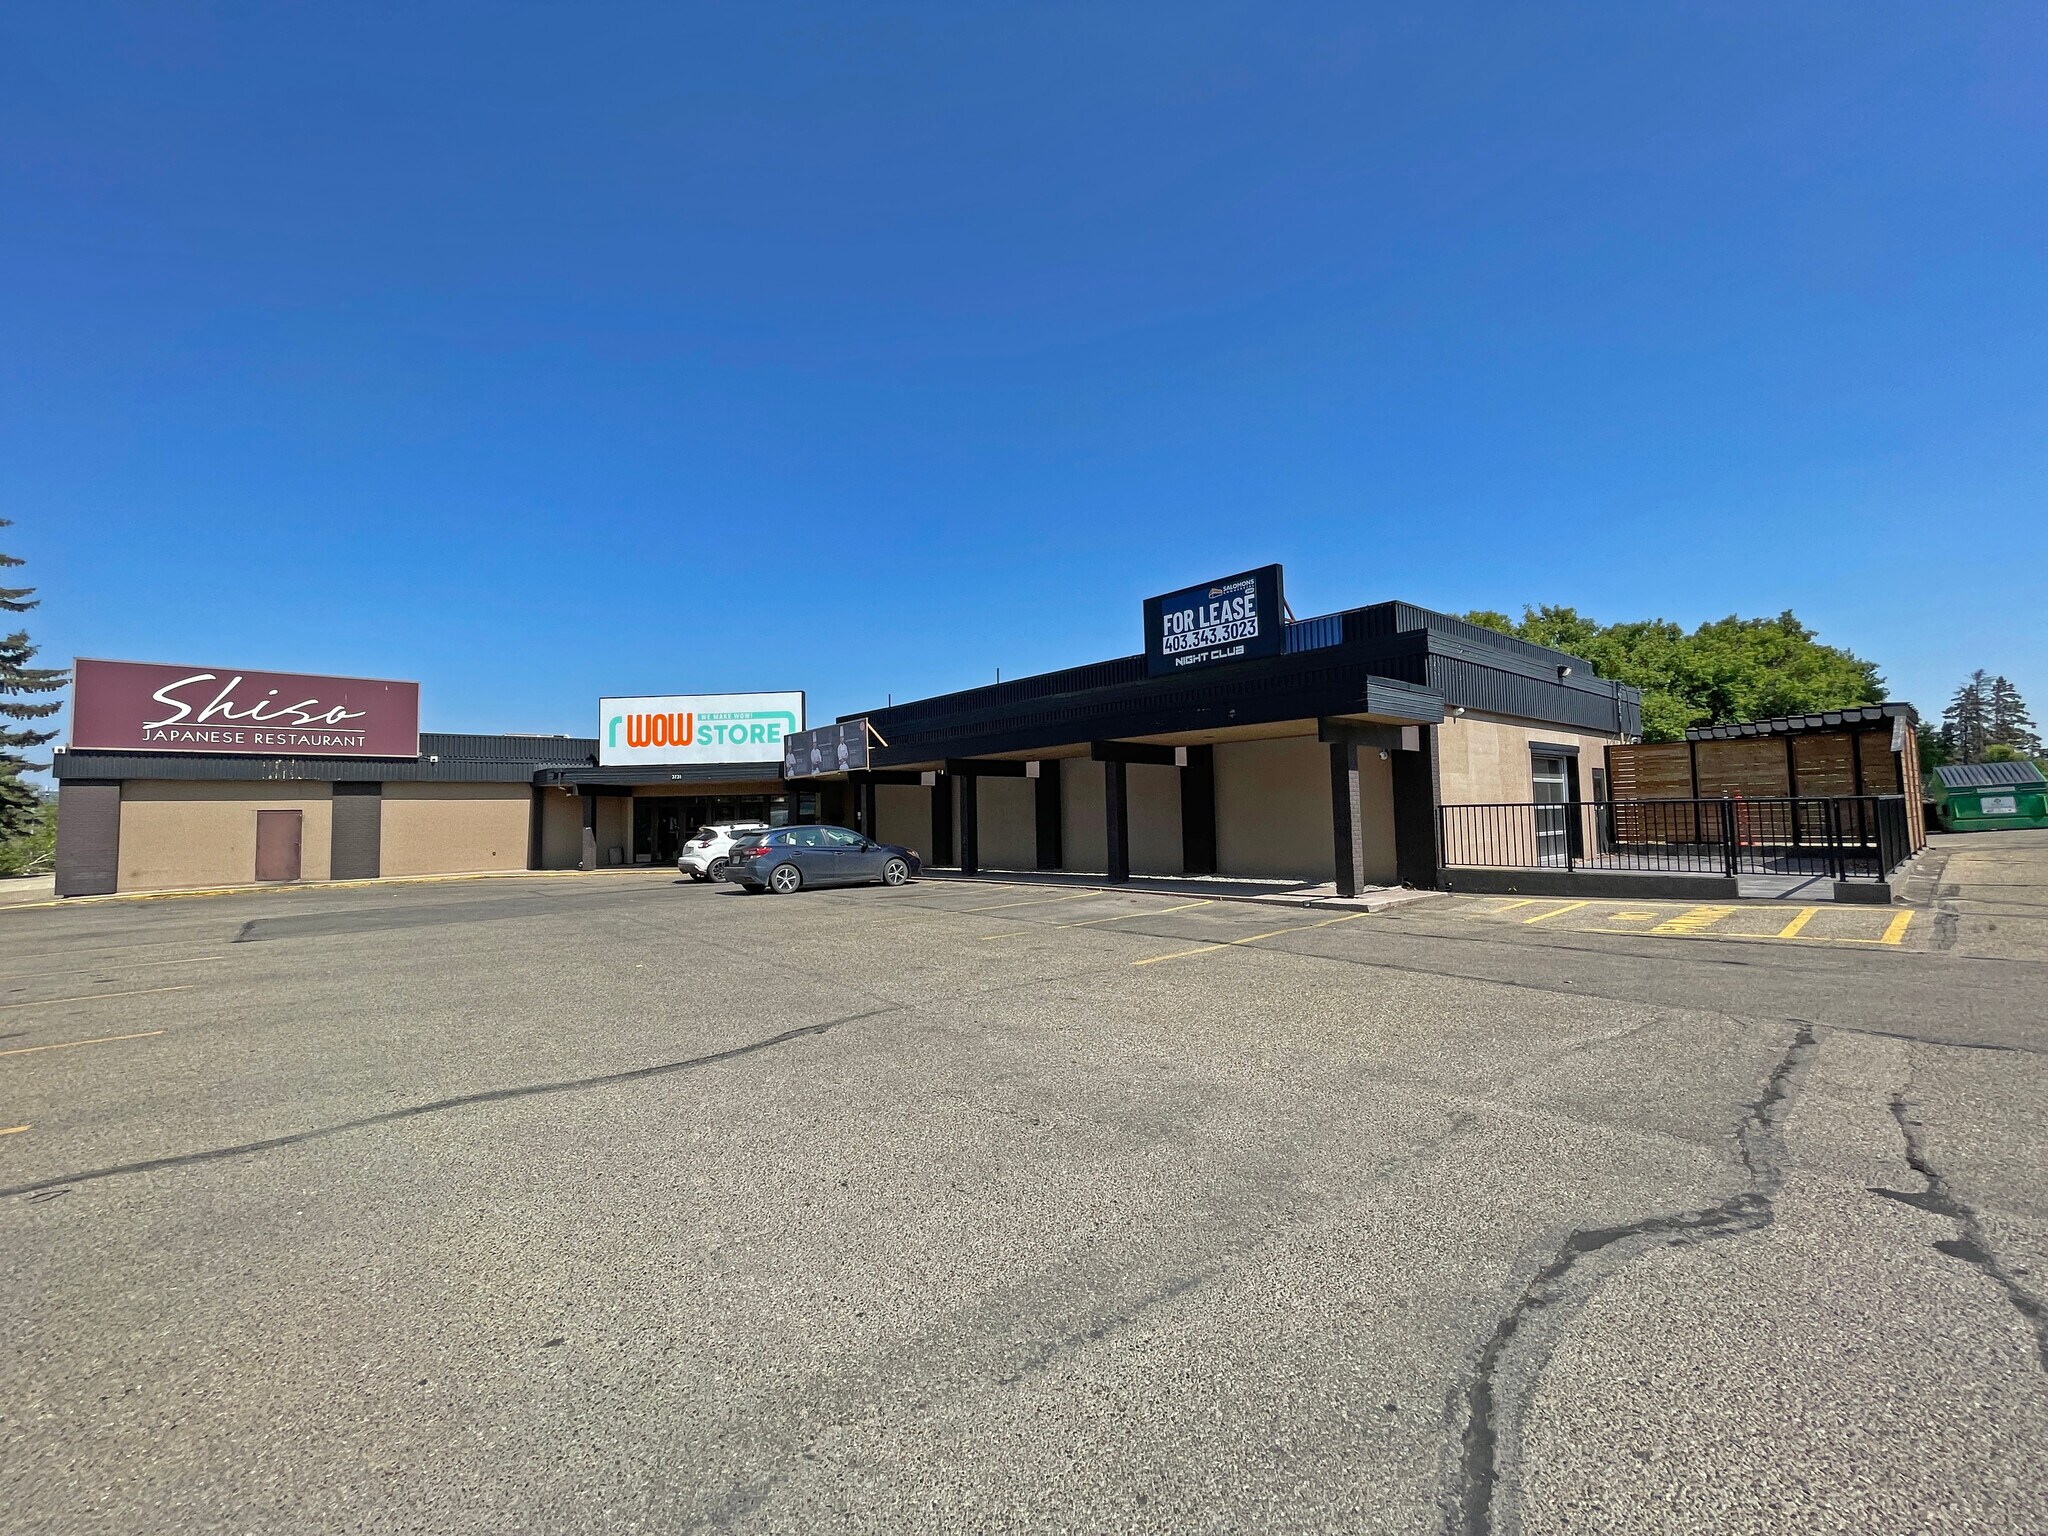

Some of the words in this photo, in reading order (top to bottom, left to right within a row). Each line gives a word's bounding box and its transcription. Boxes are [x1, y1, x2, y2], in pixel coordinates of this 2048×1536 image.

[1222, 578, 1255, 592] SALOMONS
[1163, 609, 1195, 636] FOR
[1199, 593, 1256, 629] LEASE
[1164, 618, 1256, 653] 403.343.3023
[1175, 651, 1209, 667] NIGHT
[1211, 645, 1245, 660] CLUB
[143, 673, 366, 730] Shiso
[713, 712, 732, 720] MAKE
[733, 711, 753, 719] WOW!
[142, 728, 245, 744] JAPANESE
[254, 732, 366, 747] RESTAURANT
[626, 712, 693, 748] WOW
[697, 723, 781, 746] STORE
